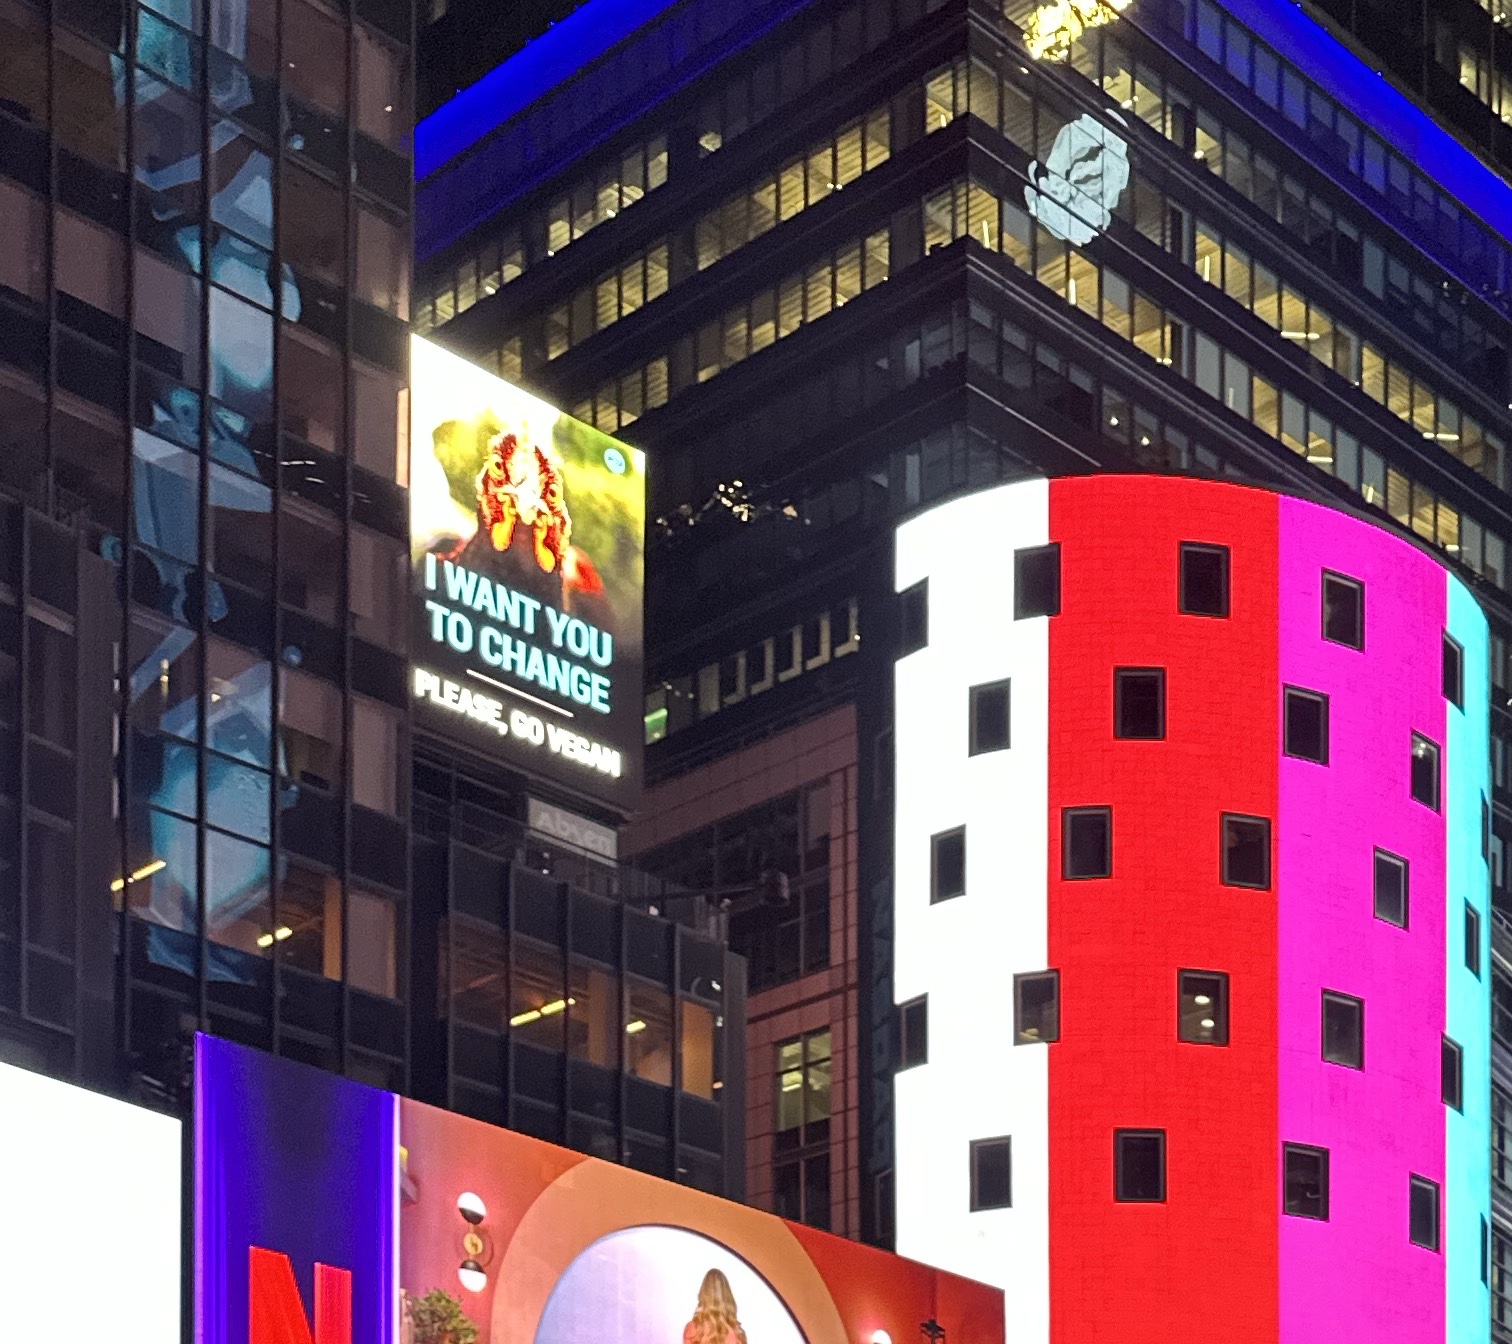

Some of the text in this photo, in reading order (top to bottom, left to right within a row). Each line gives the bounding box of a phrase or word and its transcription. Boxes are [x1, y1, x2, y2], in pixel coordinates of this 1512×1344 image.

[425, 553, 613, 667] I WANT YOU
[425, 600, 611, 714] TO CHANGE
[510, 708, 544, 745] GO
[547, 724, 621, 777] VEGAN
